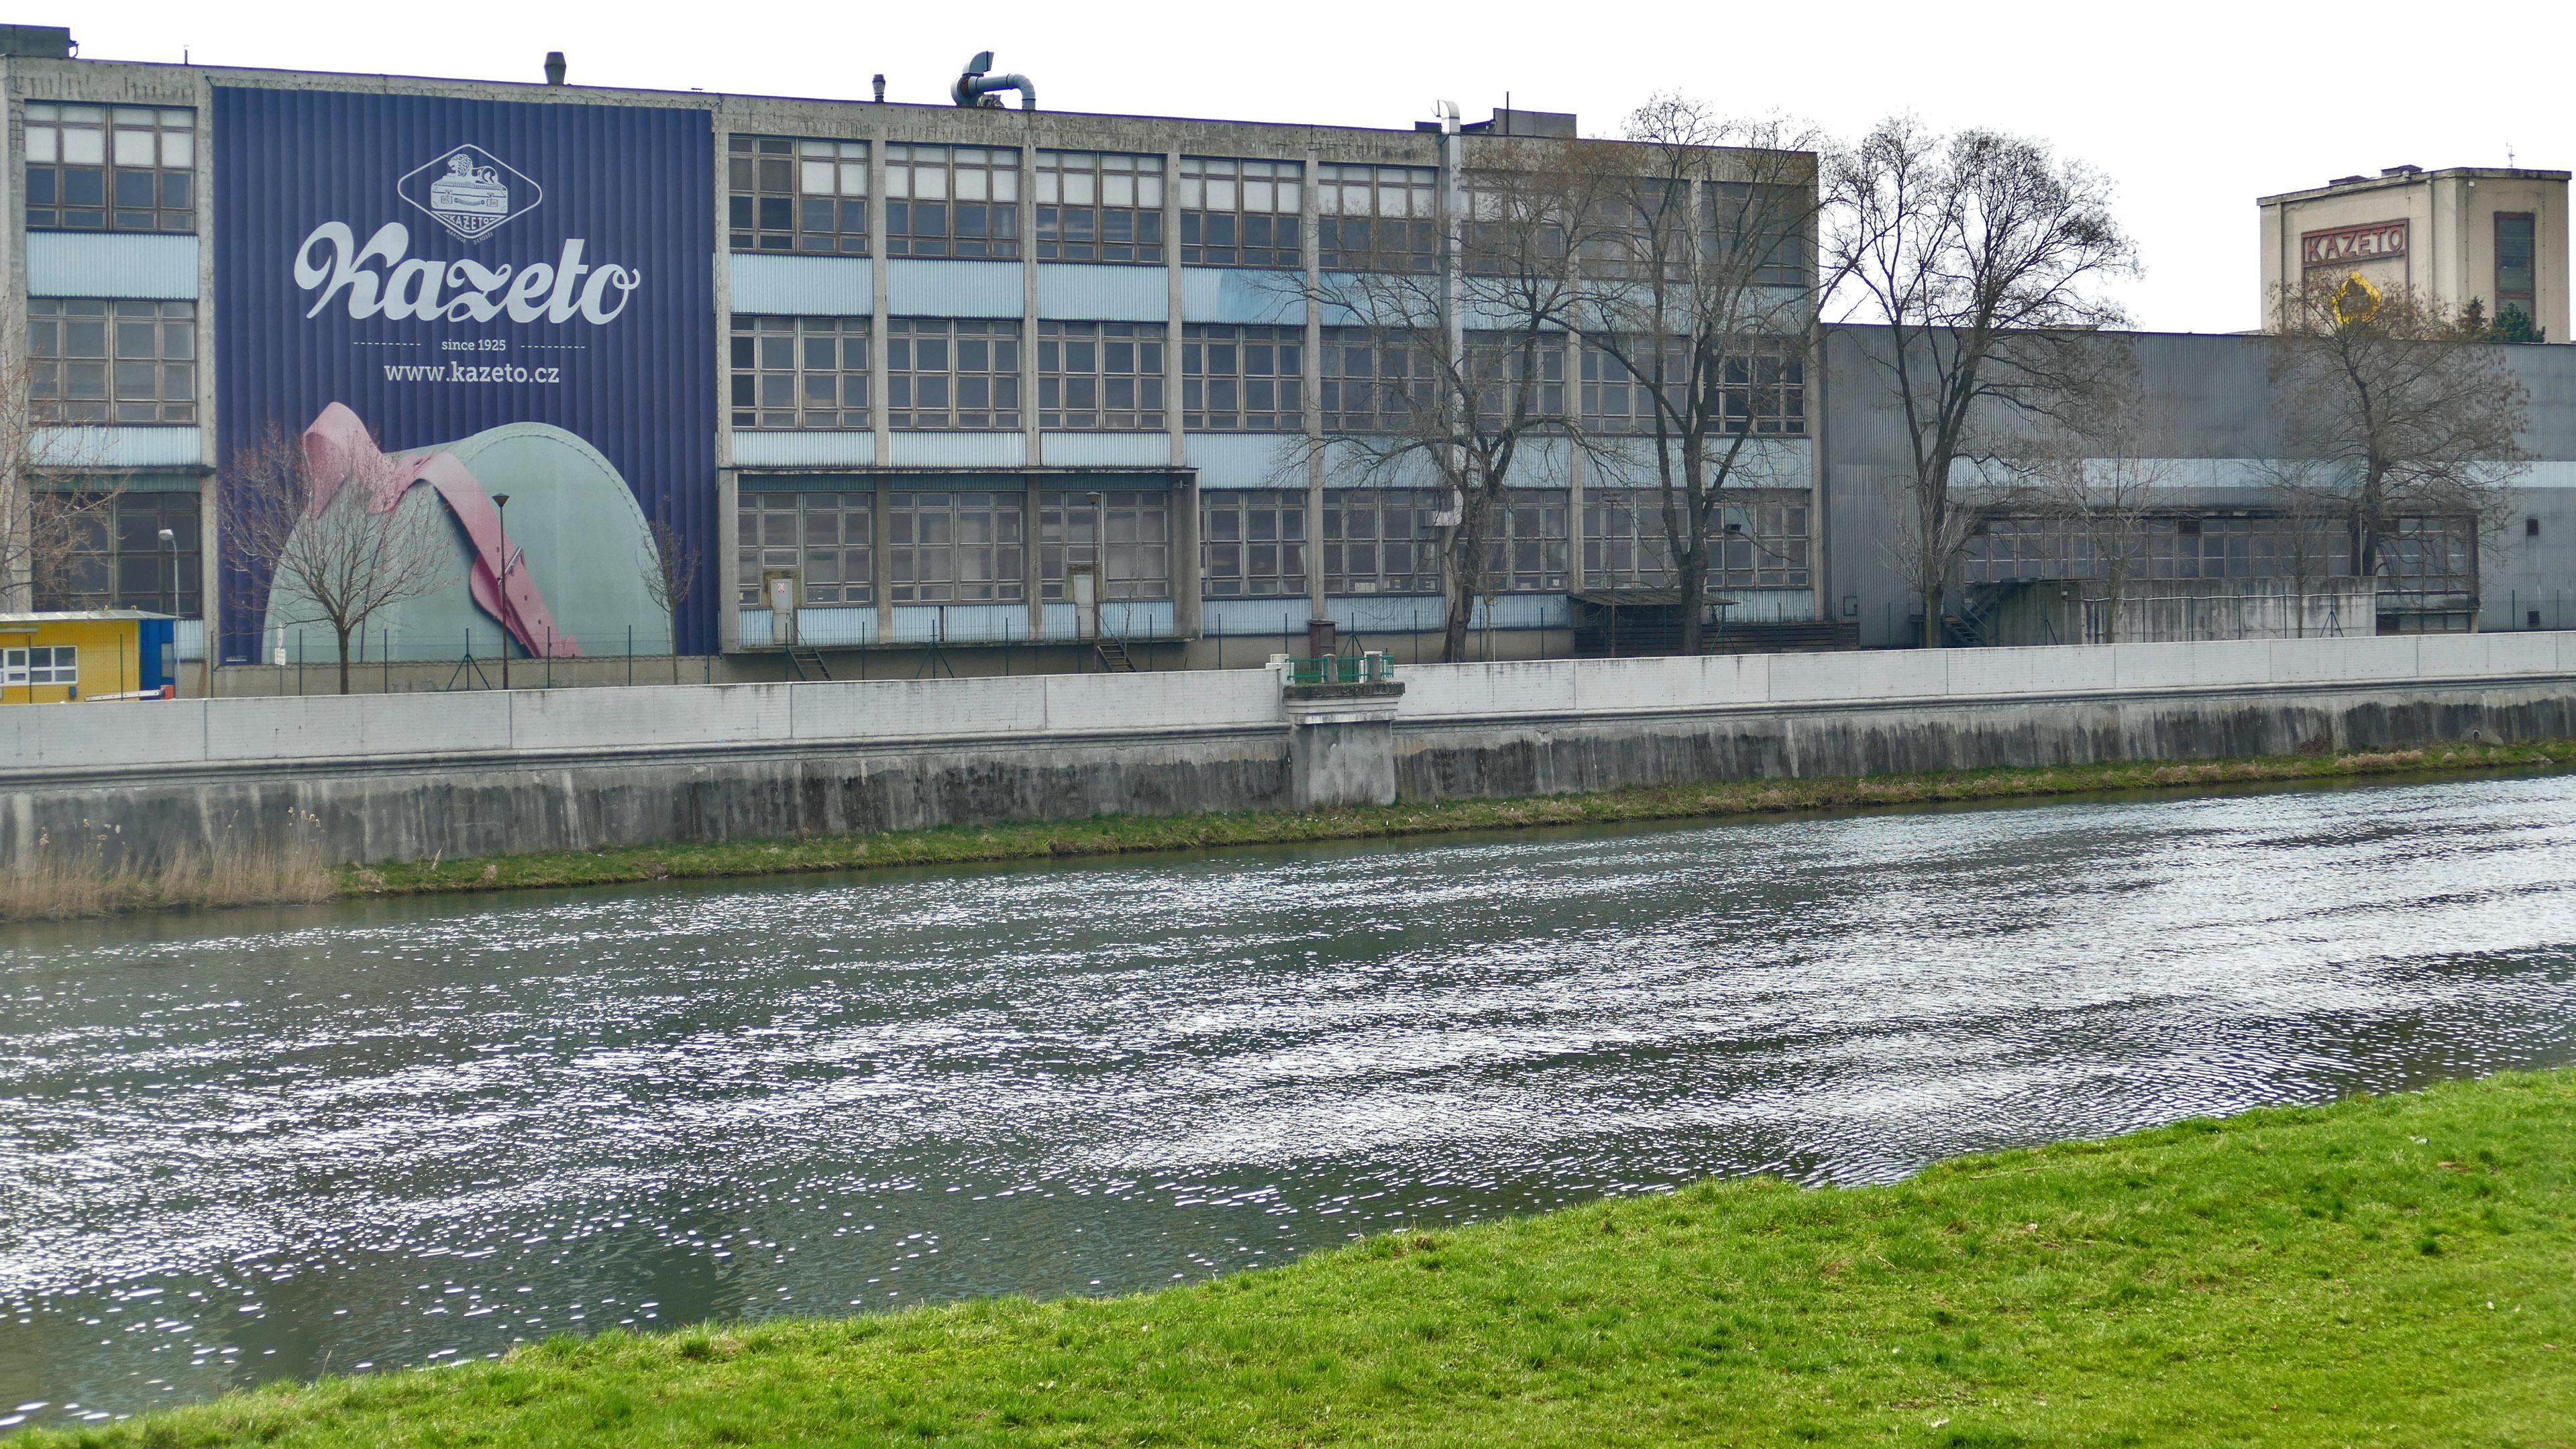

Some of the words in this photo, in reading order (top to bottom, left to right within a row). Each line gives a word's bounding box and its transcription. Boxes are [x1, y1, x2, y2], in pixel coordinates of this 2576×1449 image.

[449, 214, 489, 230] KAZETO
[2307, 225, 2404, 262] KAZETO
[294, 221, 641, 325] Kazeto
[441, 339, 475, 351] since
[478, 339, 506, 351] 1925
[384, 361, 559, 383] www.kazeto.cz
